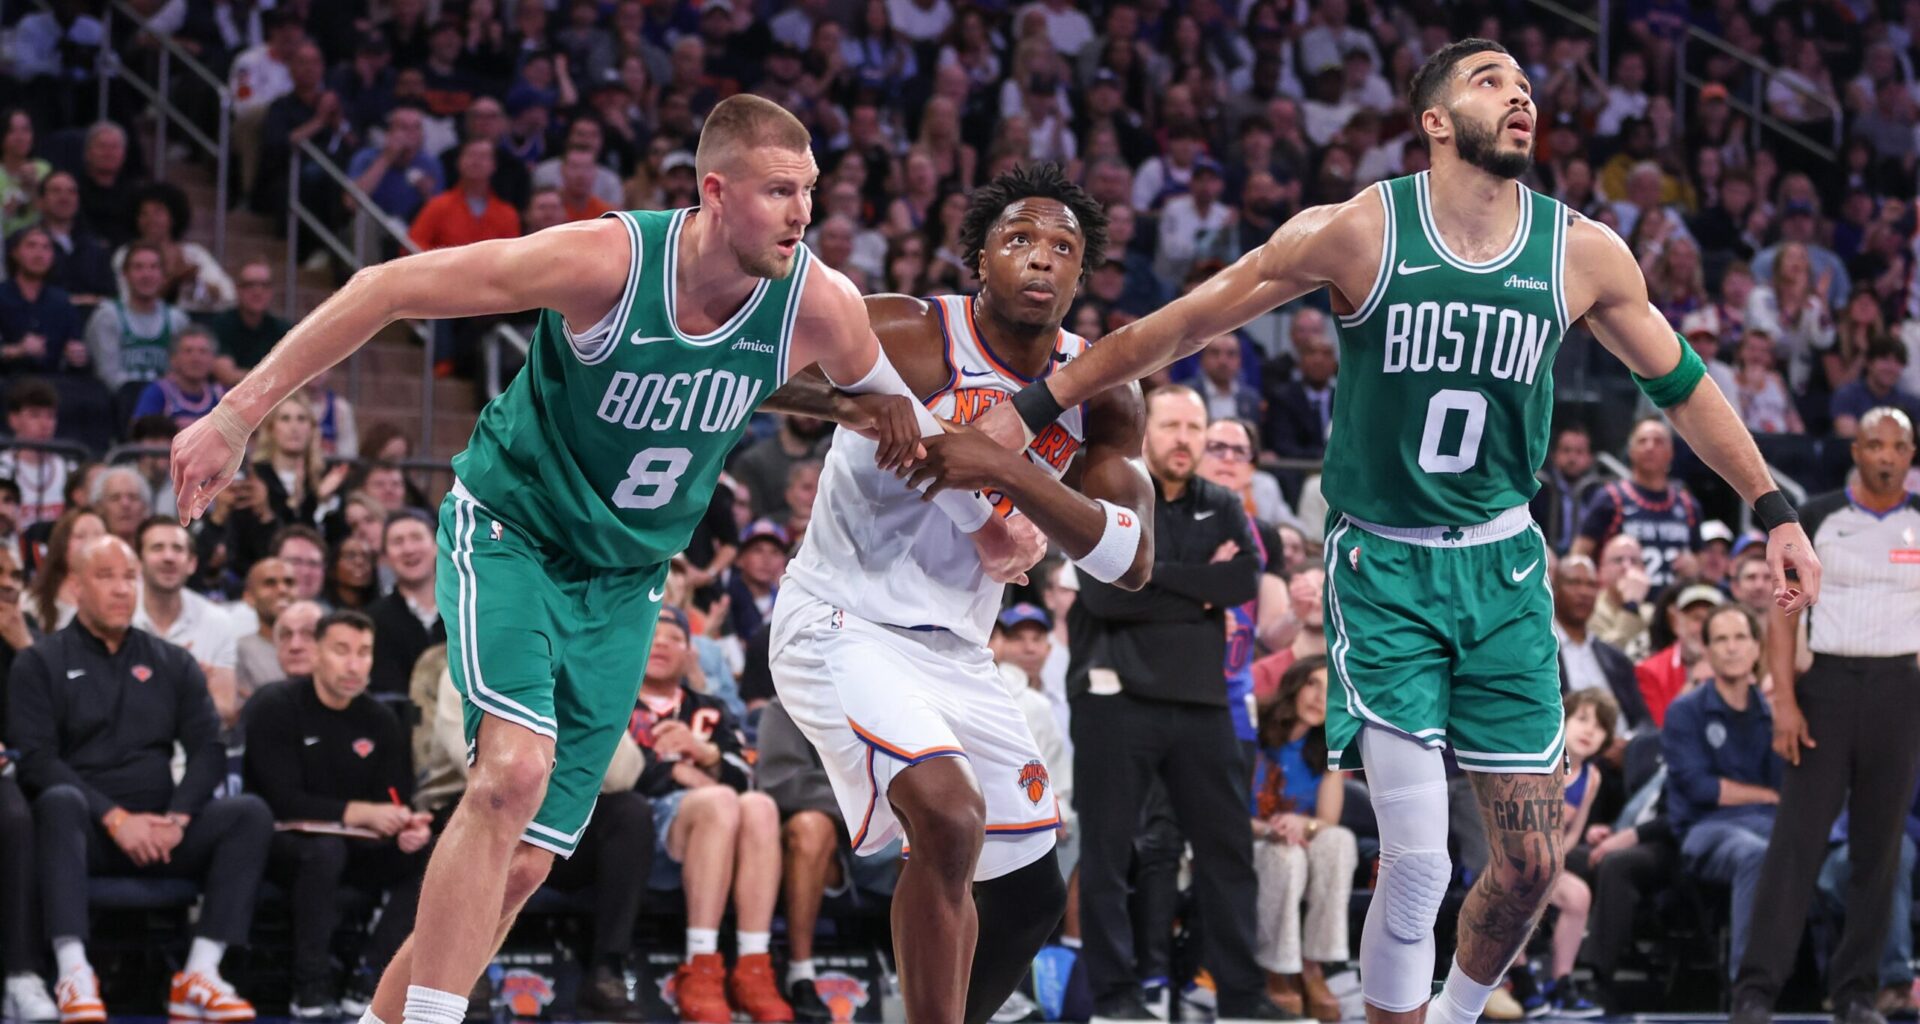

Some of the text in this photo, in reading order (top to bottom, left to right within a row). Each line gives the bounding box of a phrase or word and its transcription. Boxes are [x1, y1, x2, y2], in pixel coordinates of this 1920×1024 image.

[1504, 274, 1548, 291] Amica
[731, 337, 775, 354] Amica
[1383, 301, 1551, 385] BOSTON
[596, 368, 763, 433] BOSTON
[952, 388, 1014, 424] NE
[1418, 388, 1488, 473] 0
[611, 447, 693, 510] 8
